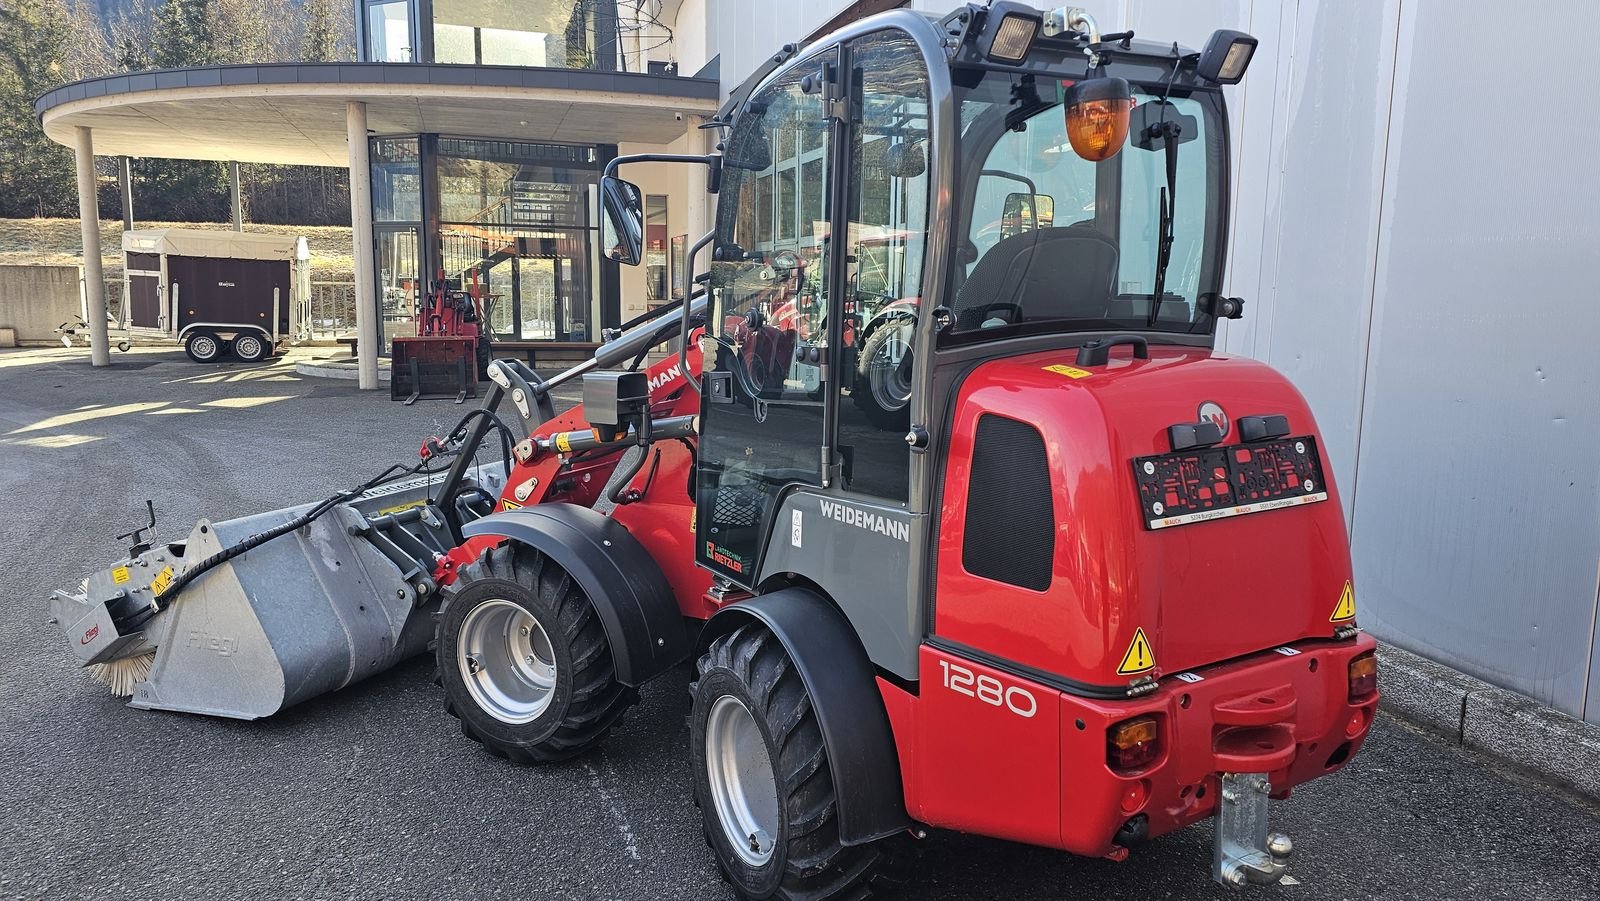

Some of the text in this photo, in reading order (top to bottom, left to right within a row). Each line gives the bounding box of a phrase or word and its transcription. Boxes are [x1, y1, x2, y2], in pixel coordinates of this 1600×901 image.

[820, 500, 910, 542] WEIDEMANN
[714, 544, 742, 562] LANDTECHNIK
[714, 551, 742, 573] RIETZLER
[940, 660, 1037, 718] 1280
